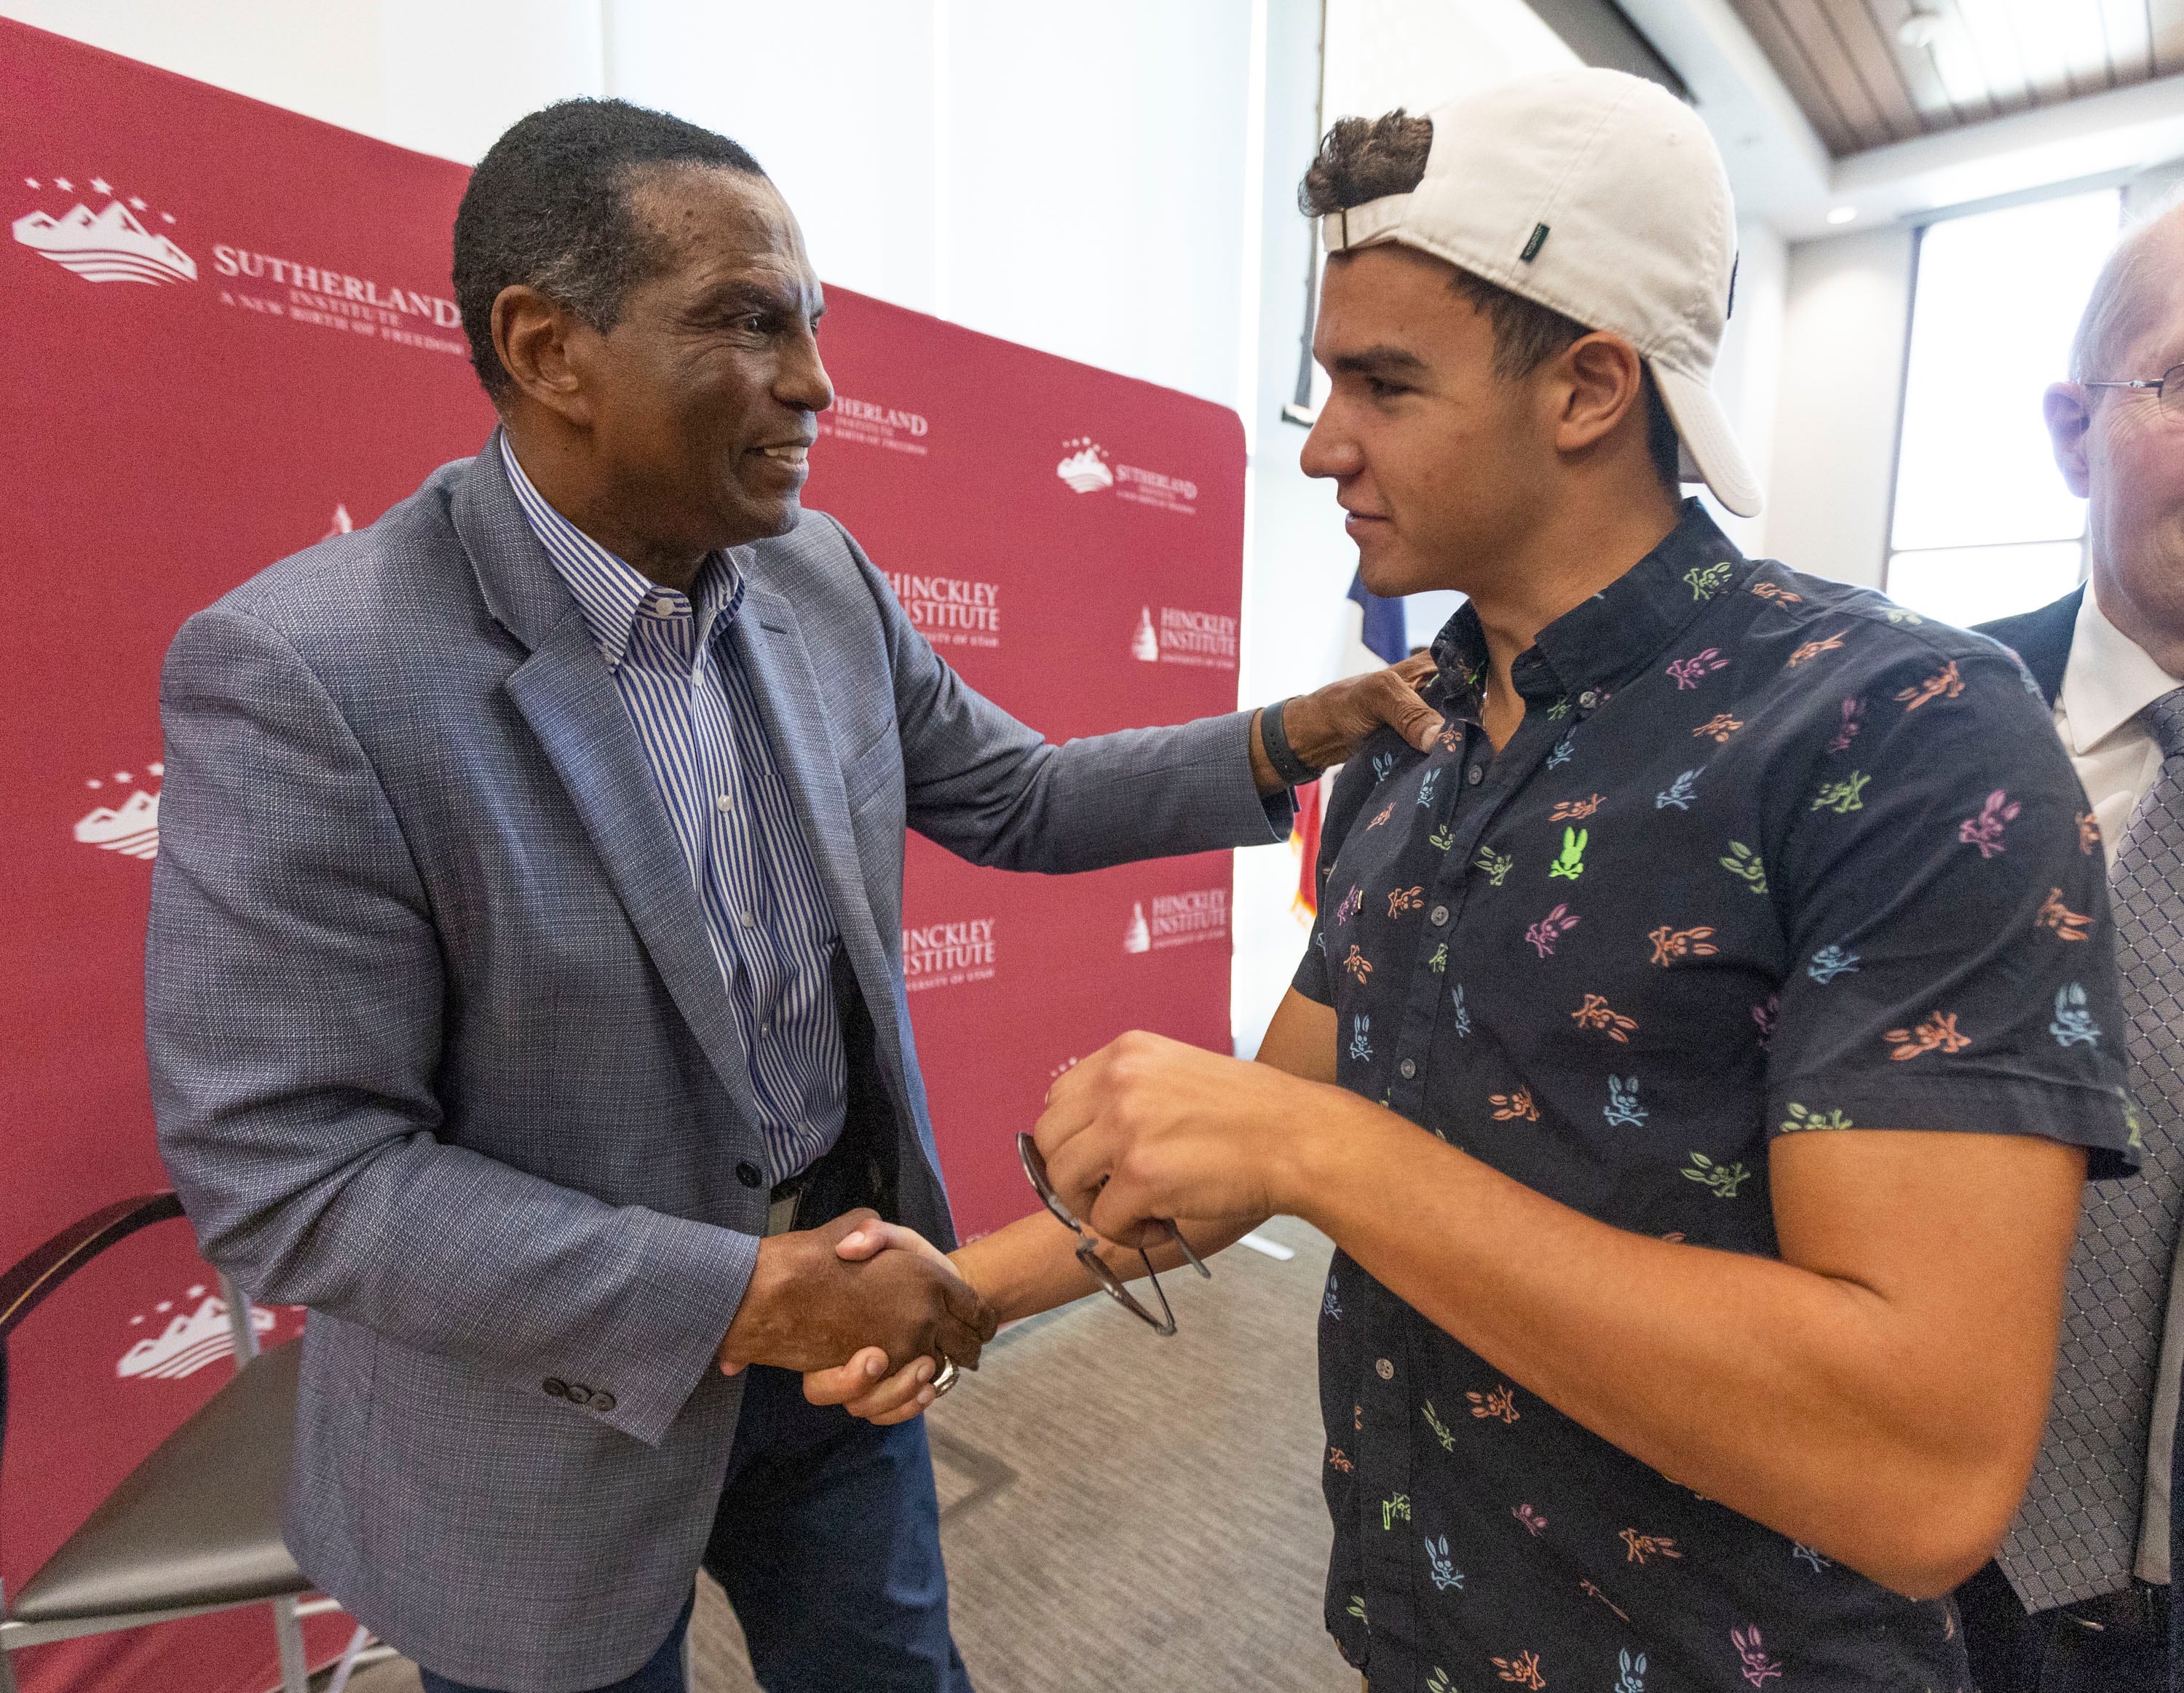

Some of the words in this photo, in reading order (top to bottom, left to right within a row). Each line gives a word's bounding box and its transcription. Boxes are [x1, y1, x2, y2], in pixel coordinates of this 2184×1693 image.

[213, 244, 463, 329] SUTHERLAND
[828, 395, 928, 437] HERLAND
[884, 571, 1000, 606] HINCKLEY
[905, 598, 1001, 632] STITUTE
[902, 917, 996, 952] INCKLEY
[903, 940, 997, 976] STITUTE
